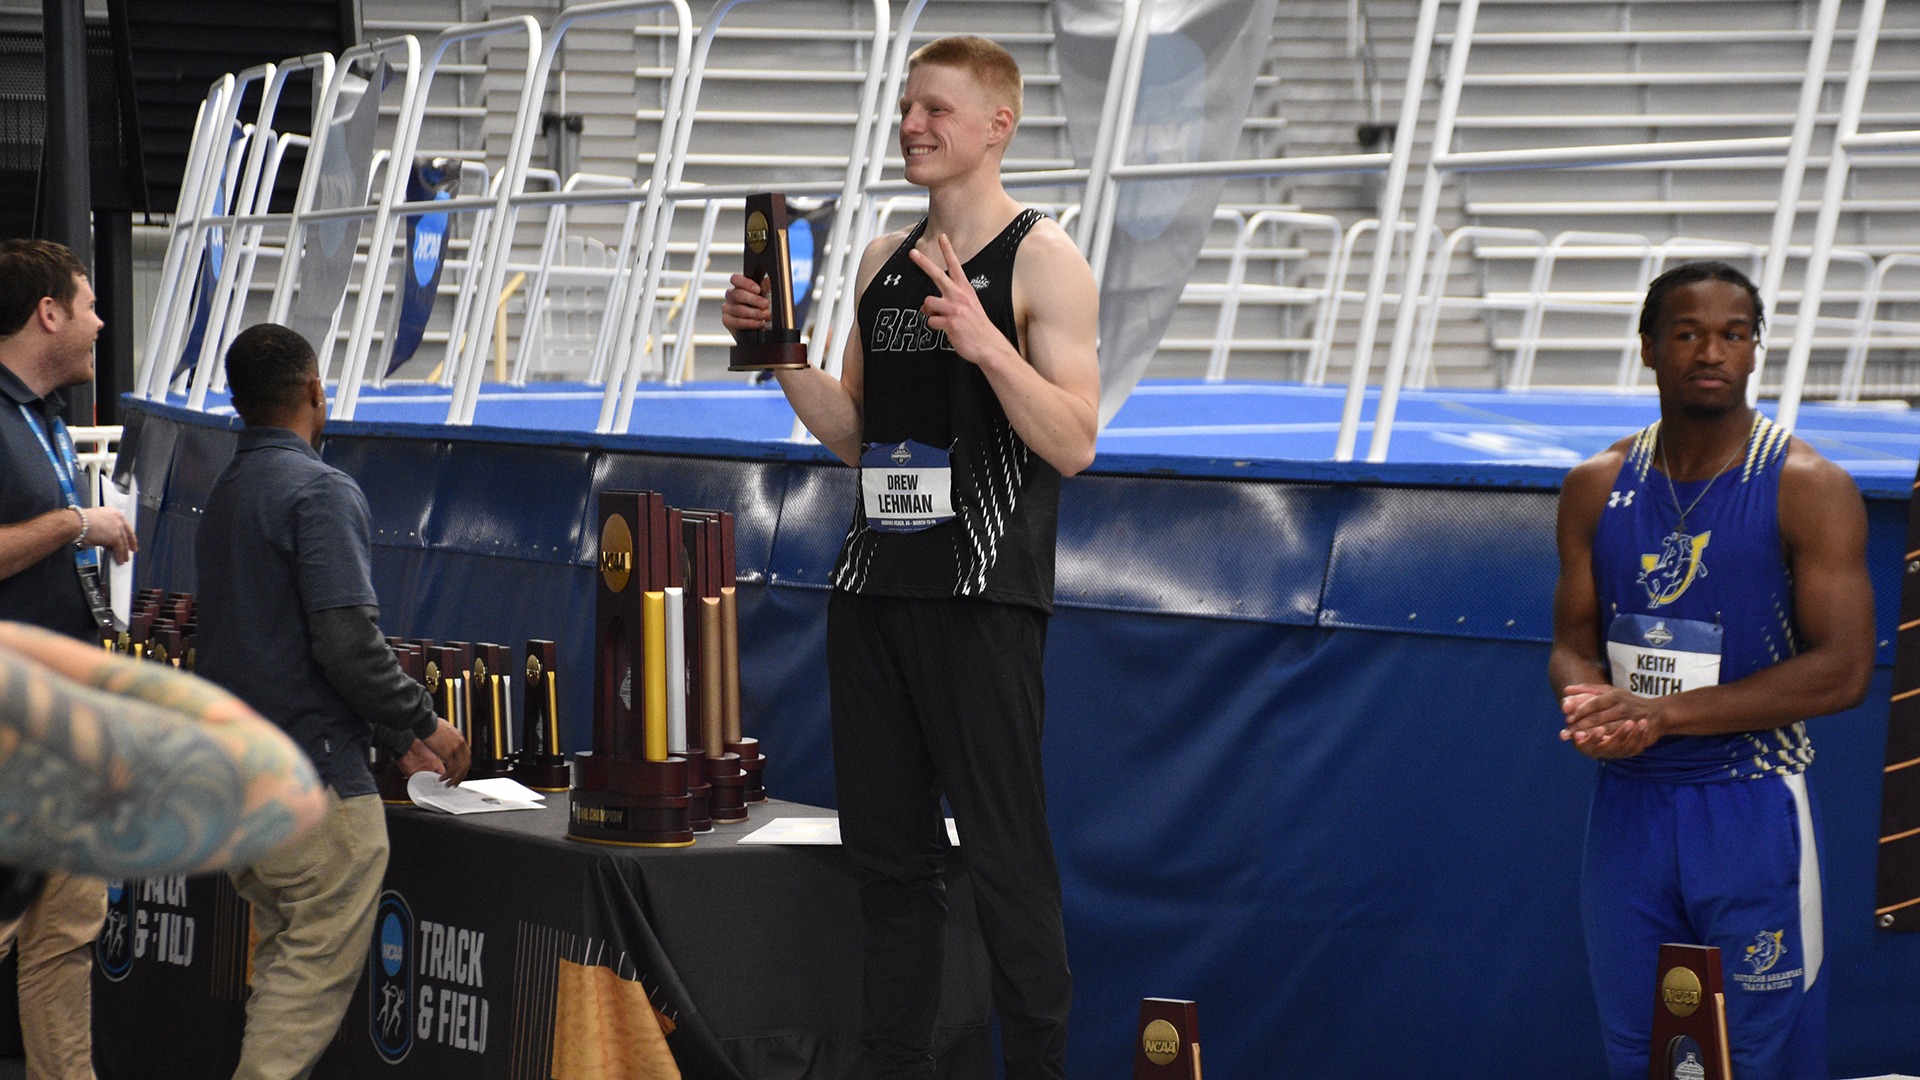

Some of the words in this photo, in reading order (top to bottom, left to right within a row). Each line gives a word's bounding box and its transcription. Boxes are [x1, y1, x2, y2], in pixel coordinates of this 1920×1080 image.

[887, 474, 919, 490] DREW
[878, 494, 933, 513] LEHMAN
[601, 551, 631, 571] NCAA
[1637, 653, 1676, 673] KEITH
[1629, 672, 1683, 697] SMITH
[420, 920, 485, 988] TRACK
[1767, 968, 1803, 982] ARKANSAS
[1742, 982, 1766, 991] TRACK
[1664, 988, 1699, 1005] NCAA
[417, 984, 434, 1040] &
[437, 988, 489, 1055] FIELD
[1145, 1040, 1177, 1054] NCAA
